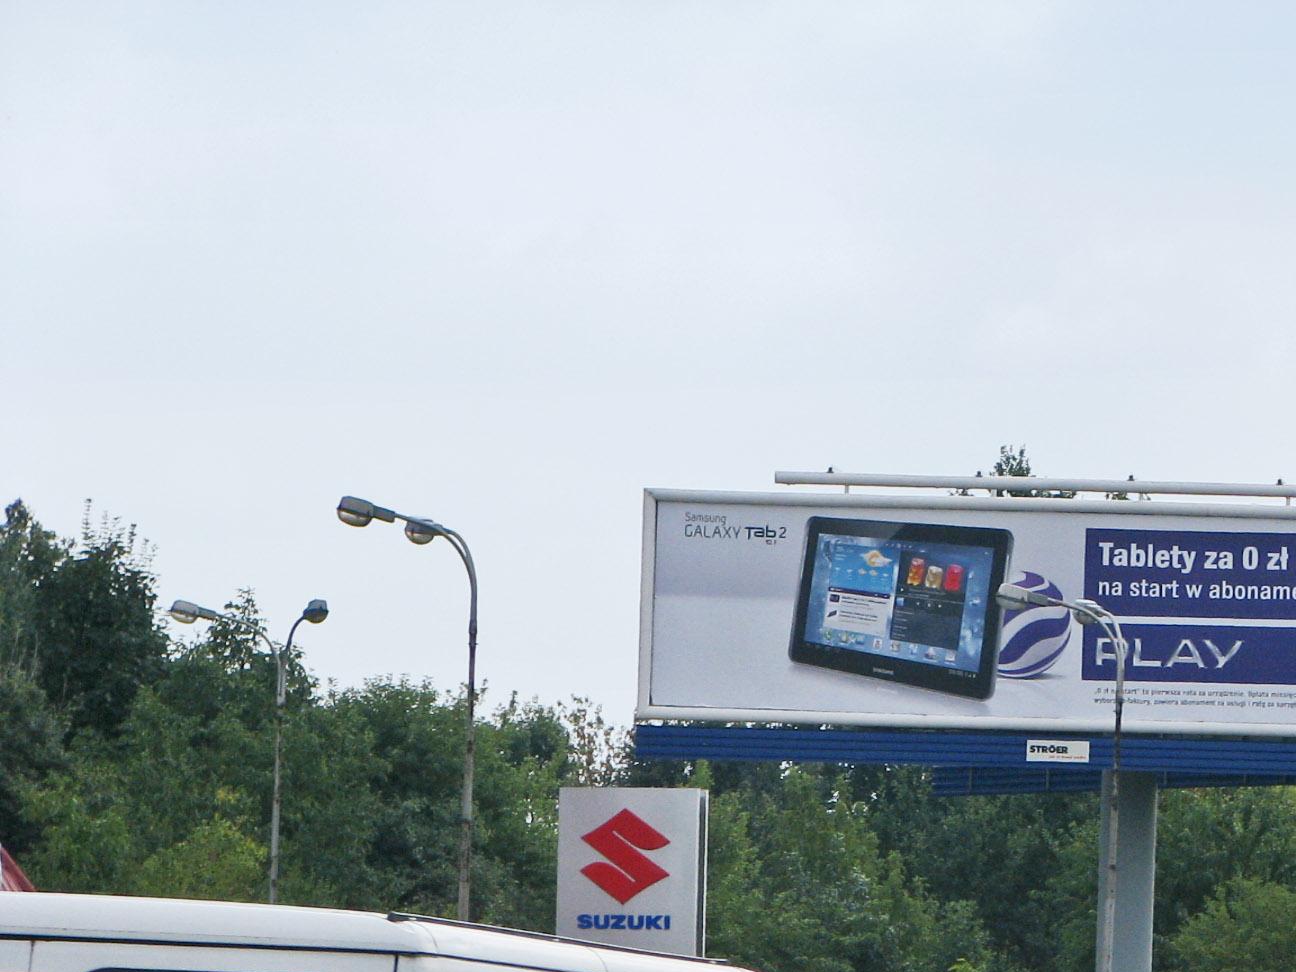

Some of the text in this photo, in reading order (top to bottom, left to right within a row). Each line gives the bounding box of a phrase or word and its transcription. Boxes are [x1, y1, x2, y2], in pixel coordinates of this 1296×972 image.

[684, 511, 727, 526] Samsung
[684, 524, 787, 540] GALAXY Tab 2
[1098, 542, 1289, 574] Tablety za 0 zł
[1098, 580, 1122, 596] na
[1130, 579, 1179, 598] start
[1186, 584, 1202, 598] w
[1095, 637, 1245, 669] PLAY
[576, 913, 671, 931] SUZUKI
